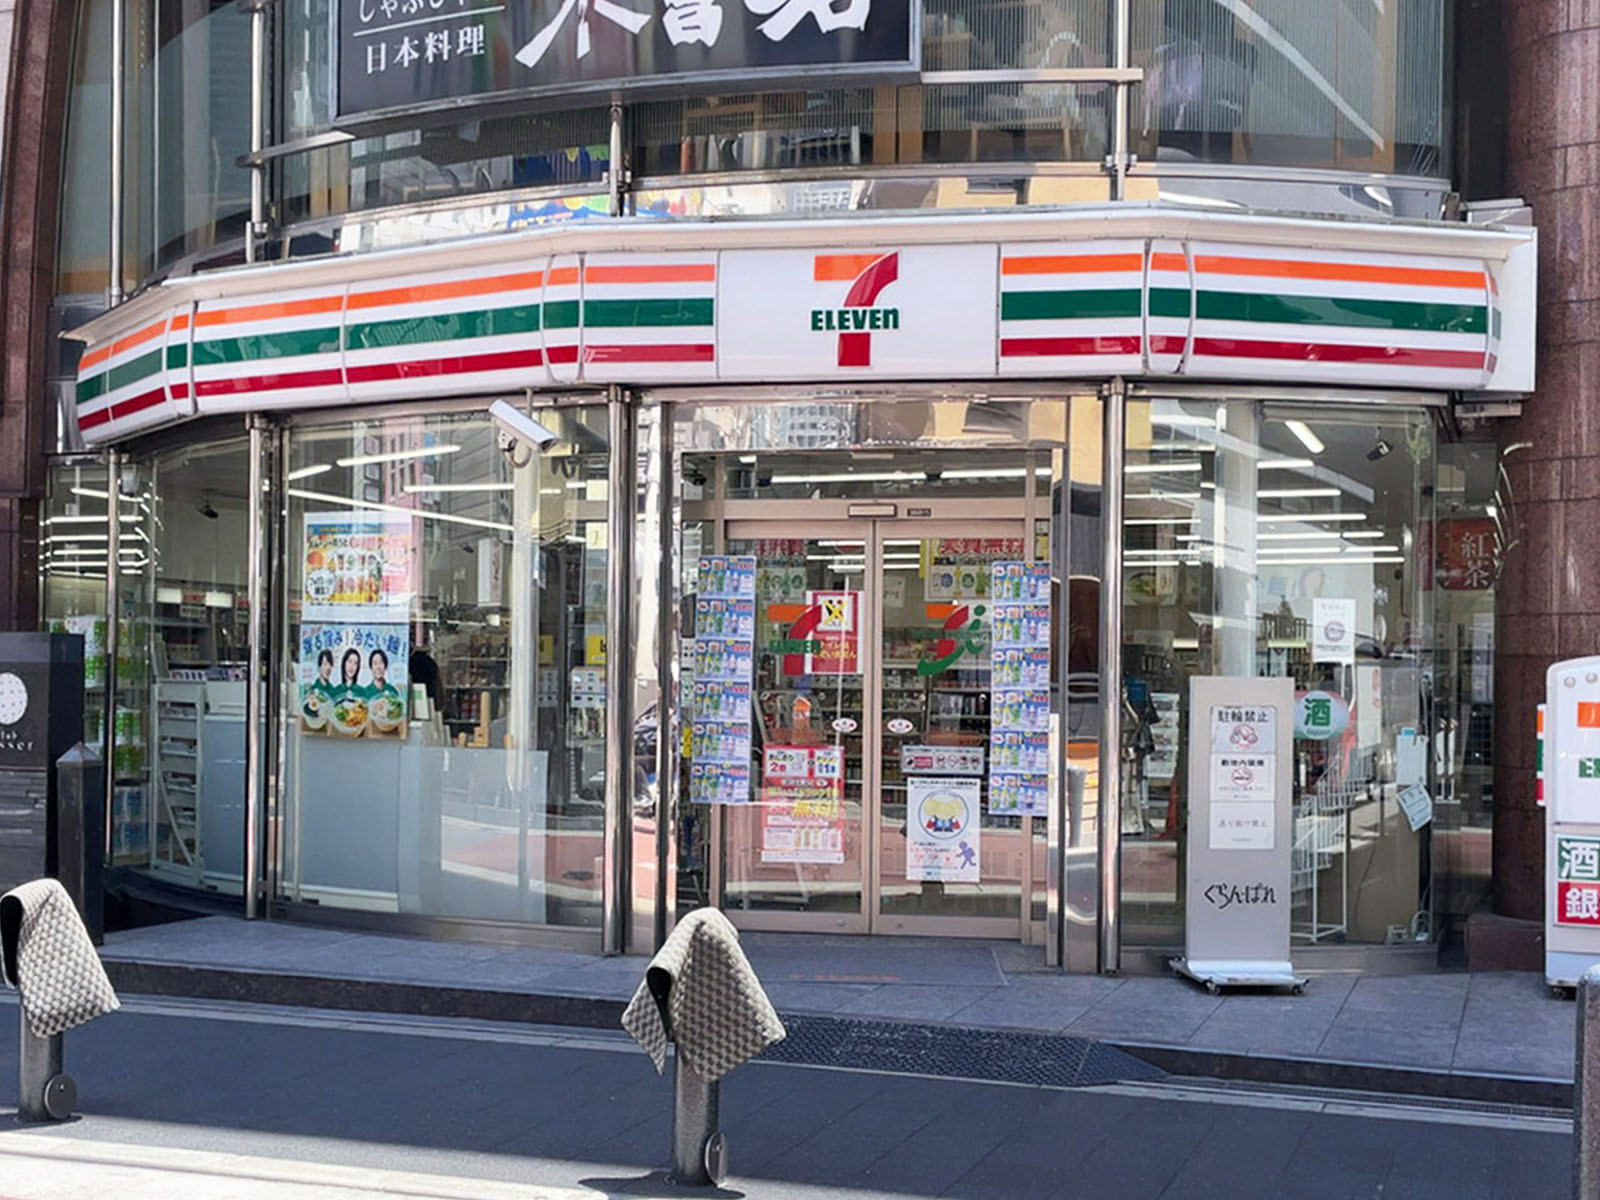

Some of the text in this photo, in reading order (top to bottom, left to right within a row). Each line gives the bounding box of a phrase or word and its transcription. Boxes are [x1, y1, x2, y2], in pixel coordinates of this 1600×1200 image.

[367, 23, 485, 74] 日本料理
[1218, 710, 1269, 723] 駐輪禁止
[1304, 698, 1331, 726] 酒
[1561, 841, 1600, 879] 酒
